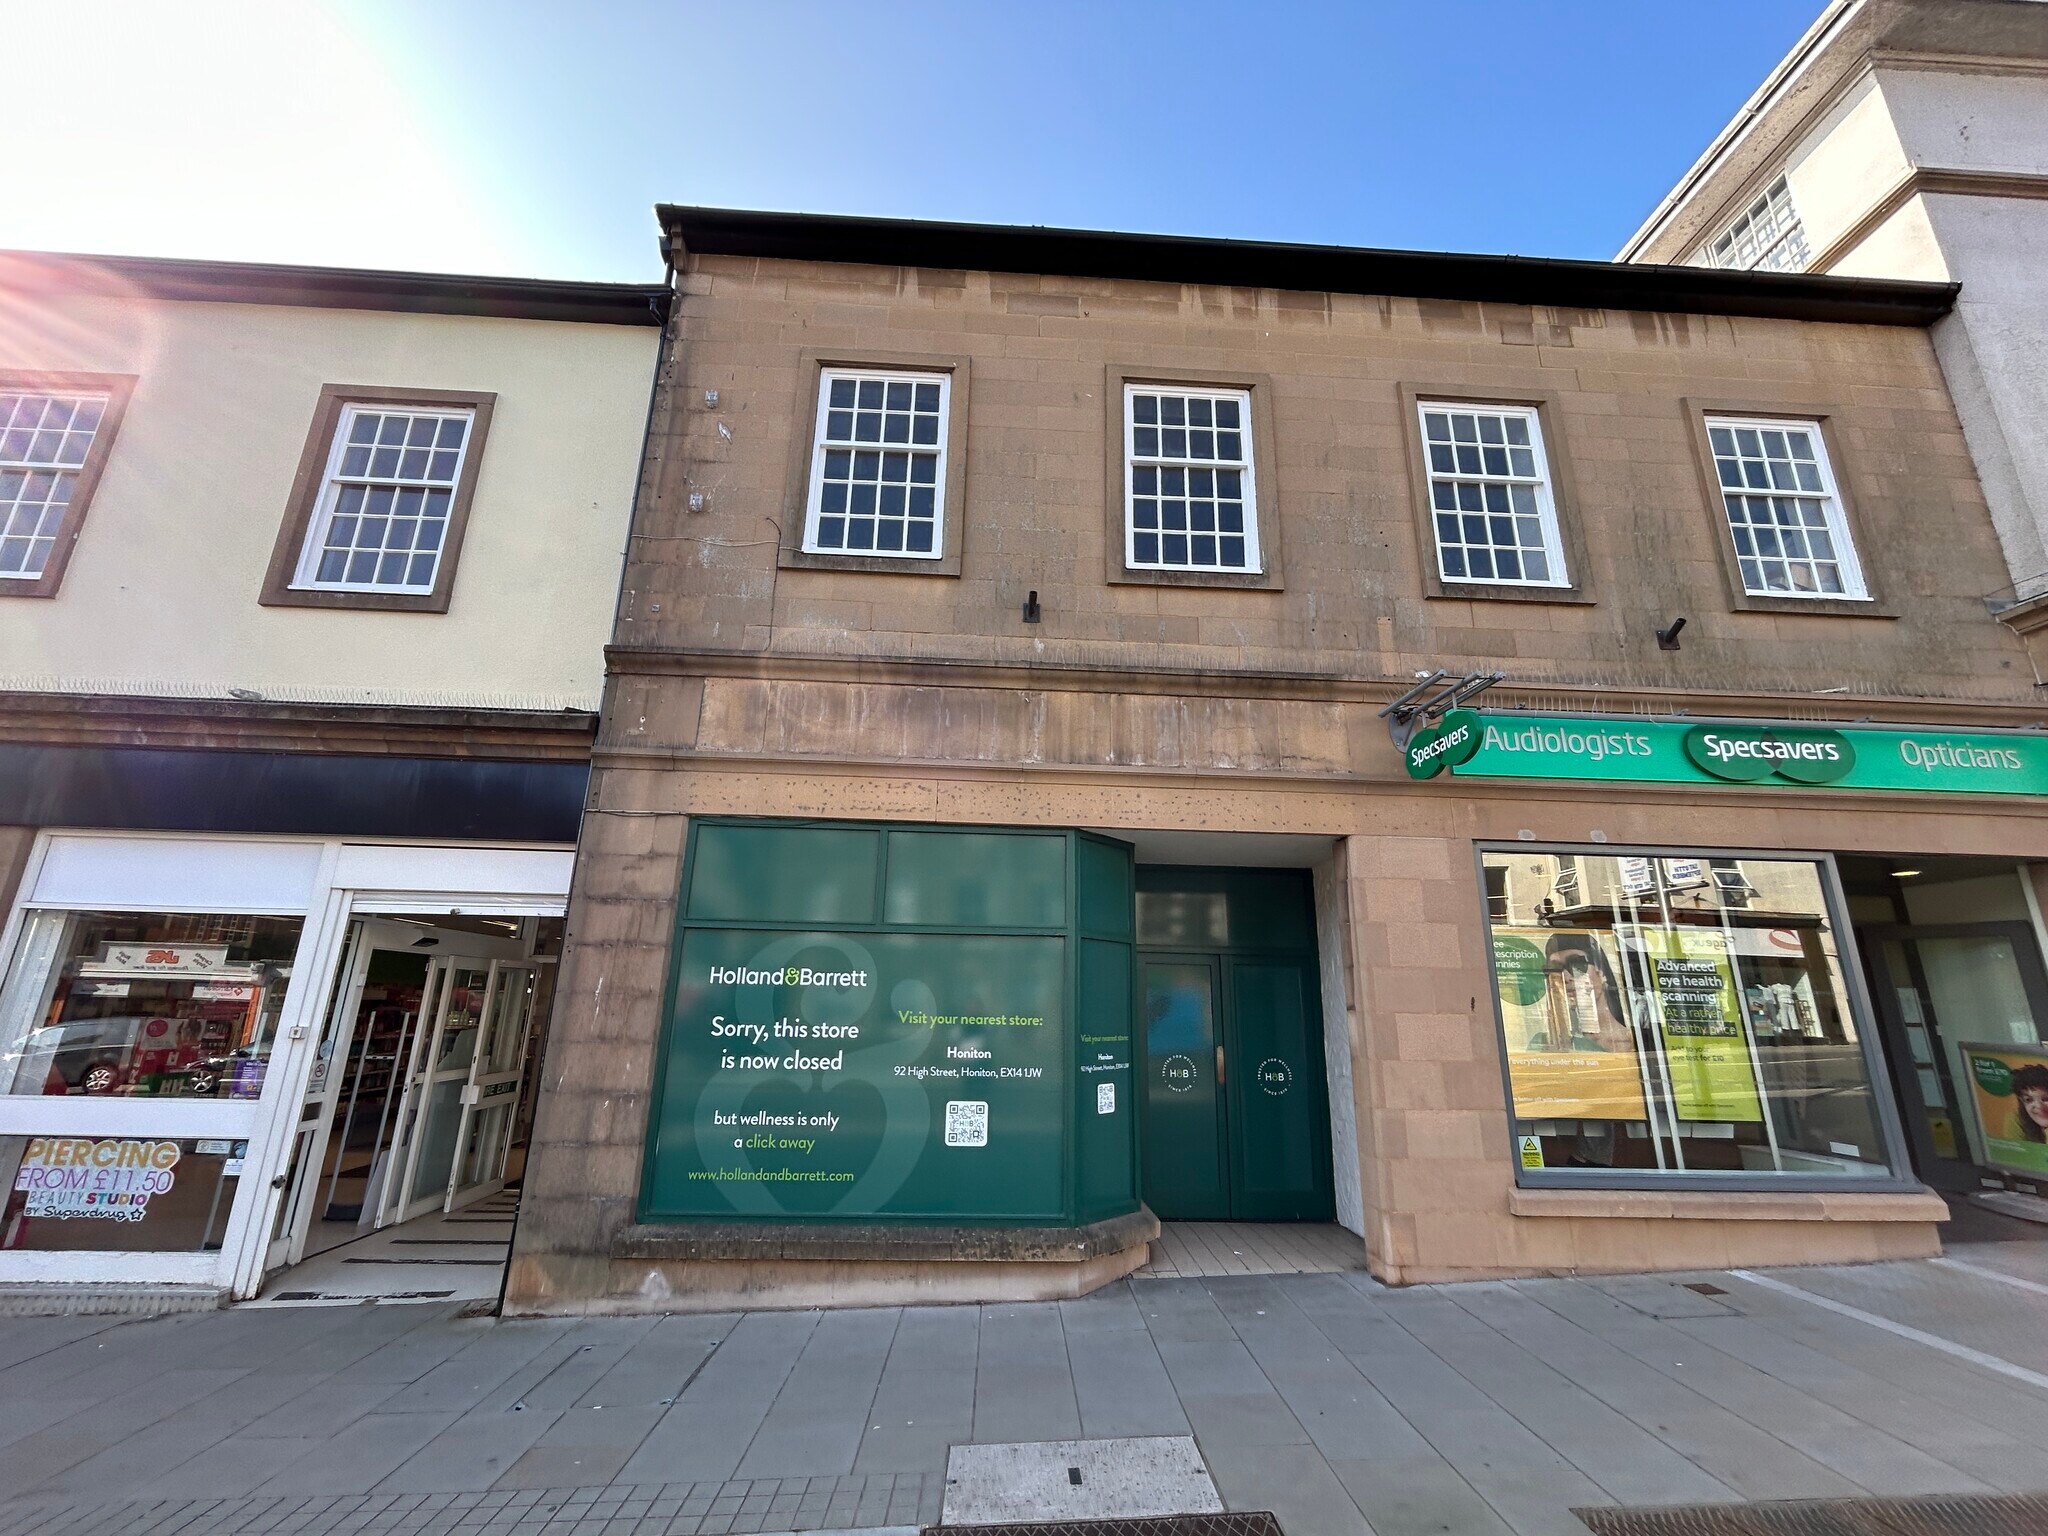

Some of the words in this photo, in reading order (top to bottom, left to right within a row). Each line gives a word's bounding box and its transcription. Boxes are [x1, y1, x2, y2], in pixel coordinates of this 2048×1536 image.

[1411, 724, 1469, 767] Specsavers
[1484, 725, 1652, 761] Audiologists
[1703, 734, 1840, 762] Specsavers
[1900, 739, 2022, 772] Opticians
[1657, 960, 1716, 972] Advanced
[709, 966, 868, 987] Holland&Barrett
[1659, 977, 1680, 987] eye
[1682, 975, 1723, 986] health
[1662, 991, 1716, 1004] scanning
[898, 1010, 928, 1025] Visit
[929, 1015, 958, 1029] your
[960, 1015, 1007, 1026] nearest
[1009, 1016, 1043, 1026] store:
[1665, 1008, 1680, 1017] At
[1680, 1009, 1687, 1017] a
[710, 1016, 769, 1045] Sorry,
[773, 1017, 808, 1038] this
[811, 1022, 860, 1039] store
[1668, 1022, 1707, 1035] healthy
[721, 1049, 735, 1069] is
[740, 1056, 779, 1070] now
[783, 1049, 843, 1070] closed
[947, 1046, 992, 1059] Honiton
[1512, 1058, 1550, 1067] everything
[894, 1066, 907, 1076] 92
[907, 1066, 929, 1080] High
[930, 1066, 959, 1079] Street,
[961, 1067, 999, 1079] Honiton,
[1000, 1067, 1022, 1078] EX14
[1024, 1067, 1043, 1078] 1JW
[713, 1110, 738, 1126] but
[740, 1111, 795, 1126] wellness
[797, 1111, 807, 1126] is
[810, 1111, 840, 1132] only
[733, 1138, 743, 1149] a
[746, 1133, 776, 1149] click
[779, 1138, 815, 1155] away
[22, 1140, 178, 1170] PIERCING
[16, 1167, 90, 1190] FROM
[93, 1168, 173, 1192] £11.50
[688, 1168, 855, 1182] www.hollandandbarrett.com
[28, 1190, 85, 1205] BEAUTY
[85, 1192, 148, 1206] STUDIO
[25, 1207, 39, 1216] BY
[43, 1205, 127, 1220] Superdrug
